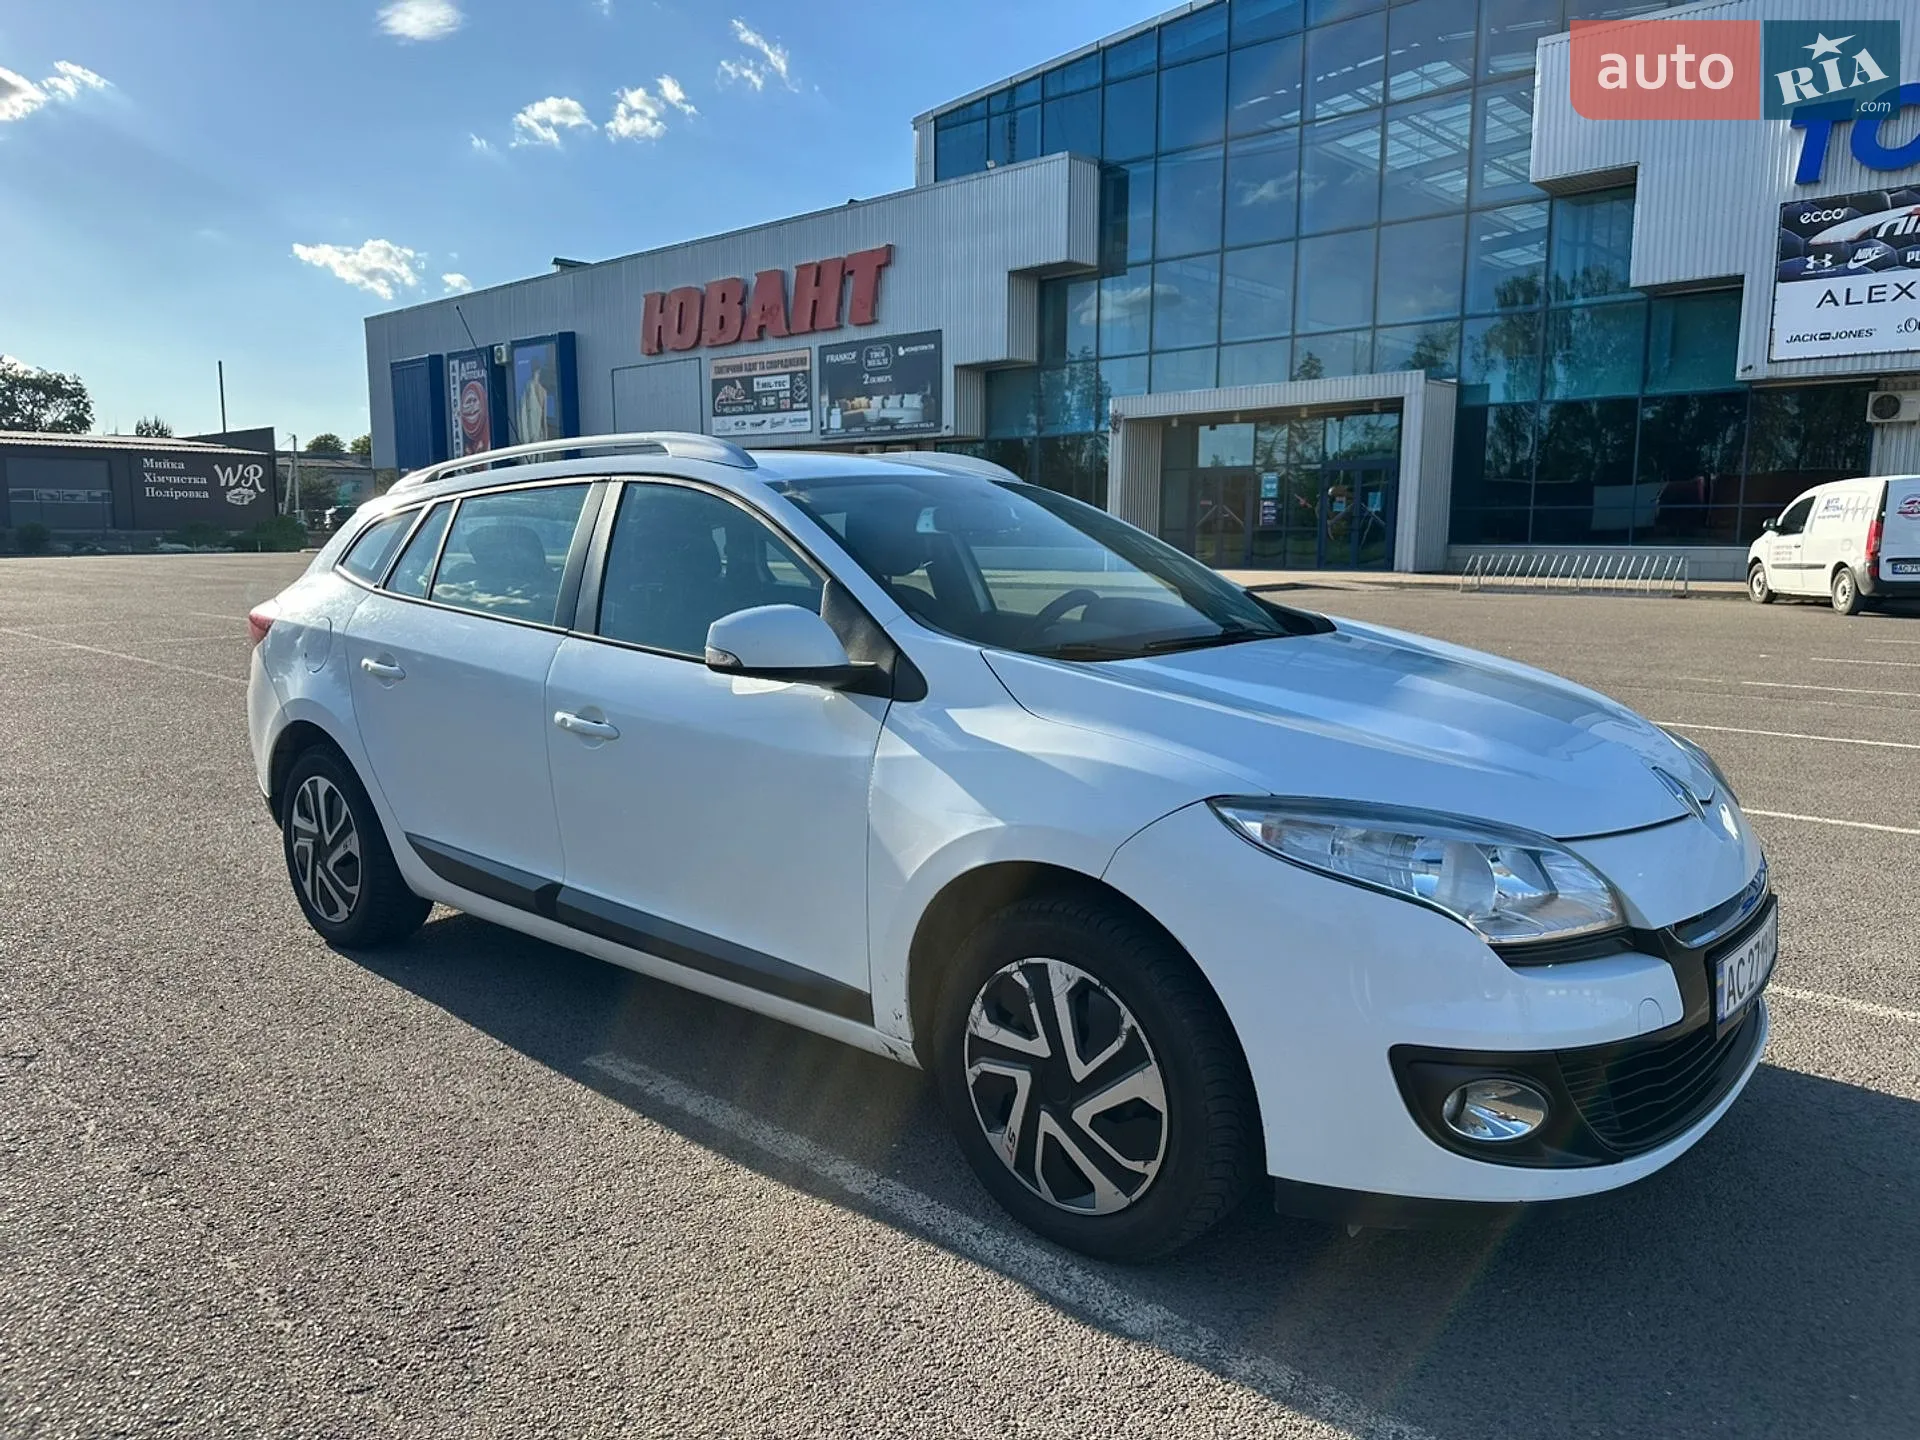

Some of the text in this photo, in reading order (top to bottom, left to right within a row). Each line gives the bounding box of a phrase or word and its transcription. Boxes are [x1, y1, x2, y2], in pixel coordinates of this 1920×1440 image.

[1800, 208, 1844, 224] ecco
[1853, 247, 1881, 261] NIKE
[641, 244, 895, 356] ЮВАНТ
[1816, 281, 1917, 309] ALEX
[142, 458, 185, 470] Мийка
[144, 472, 207, 484] Хімчистка
[214, 464, 266, 493] WR
[145, 487, 209, 500] Поліровка
